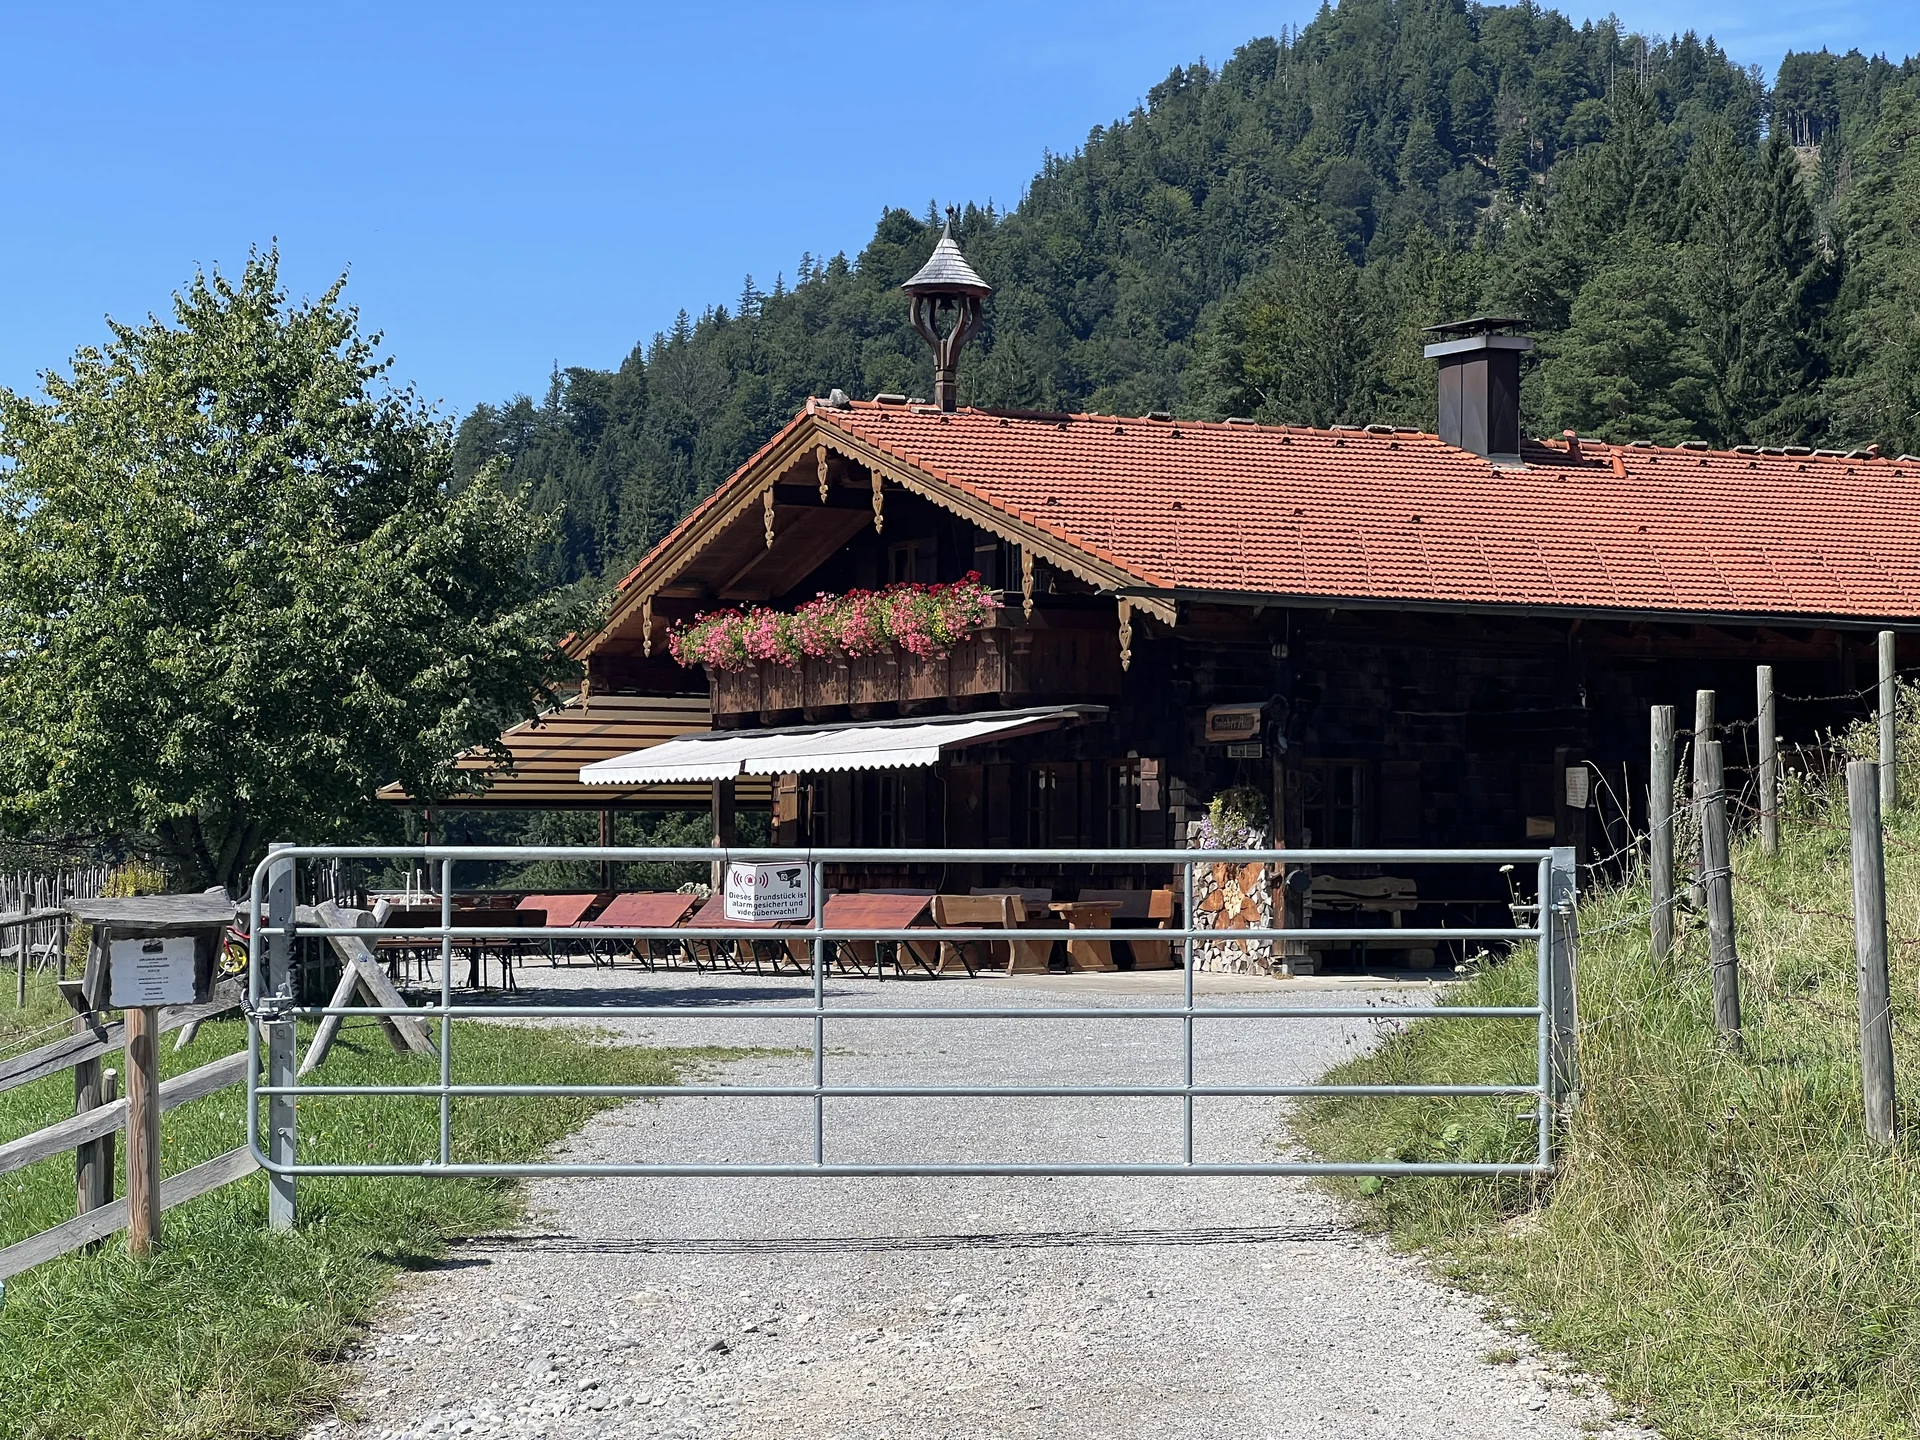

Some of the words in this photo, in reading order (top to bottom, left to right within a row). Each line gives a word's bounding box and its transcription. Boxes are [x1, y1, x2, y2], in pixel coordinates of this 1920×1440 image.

[728, 892, 752, 900] Dieses
[754, 892, 796, 901] Grundstück
[732, 900, 788, 910] alarmgesichert
[737, 908, 798, 916] videoüberwacht!
